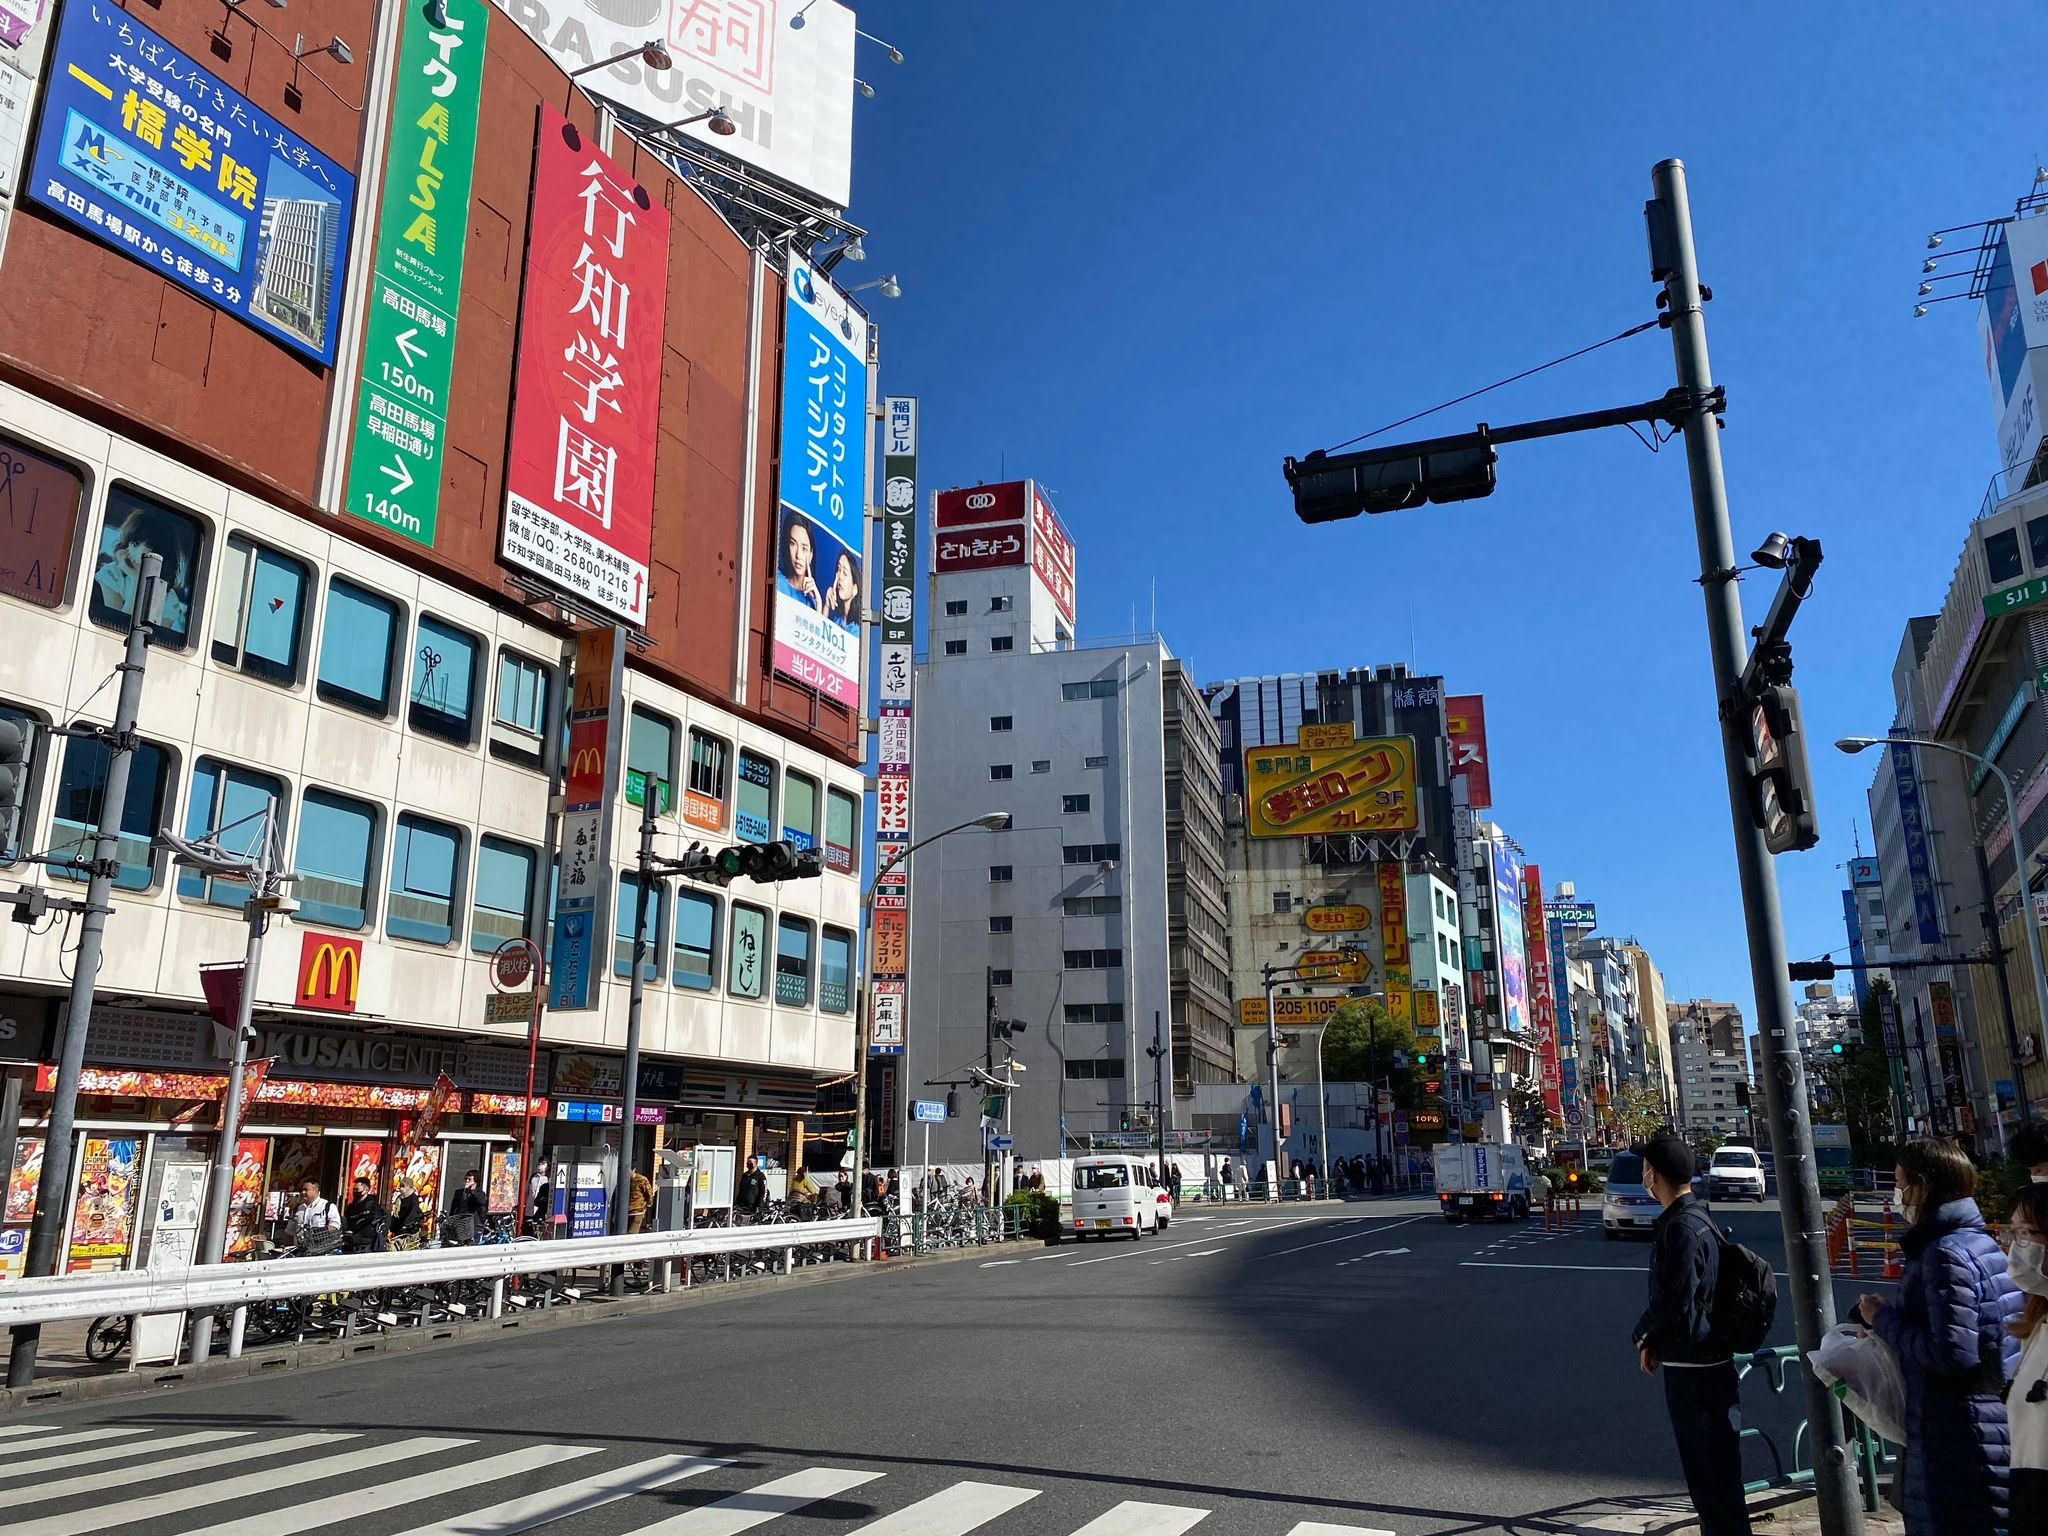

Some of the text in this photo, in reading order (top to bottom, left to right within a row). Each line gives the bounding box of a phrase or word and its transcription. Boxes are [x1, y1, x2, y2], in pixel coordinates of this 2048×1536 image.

[92, 5, 338, 192] いちばん行きたい大学へ。
[108, 53, 232, 148] 大学受験の名門
[68, 63, 259, 211] 一橋学院
[71, 156, 161, 218] メディカル
[134, 160, 189, 201] 一橋学院
[402, 102, 449, 256] ALSA
[131, 171, 236, 245] 医学部専門予備校
[47, 178, 242, 305] 高田馬場駅から徒歩3分
[166, 210, 235, 257] コネクト
[394, 261, 444, 295] 新生フィナンシャル
[382, 286, 447, 338] 高田馬場
[553, 158, 638, 531] 行知学園
[380, 361, 435, 406] 150m
[366, 415, 434, 461] 早稲田通り
[369, 392, 436, 441] 高田馬場
[806, 332, 831, 507] アイシティ
[829, 354, 848, 521] コンタクトの
[891, 400, 911, 453] 稲門ビル
[365, 492, 421, 534] 140m
[506, 539, 591, 592] 行知学园高田马场校
[940, 534, 1021, 560] さんきょう
[2006, 587, 2030, 606] SJI
[889, 630, 906, 639] 5F
[896, 719, 907, 762] 高田馬場
[1304, 736, 1349, 748] 1977
[1306, 726, 1347, 737] SINCE
[886, 764, 903, 772] 2F
[1265, 751, 1392, 823] 学生ローン
[880, 780, 892, 829] スロット
[895, 780, 907, 829] パチンコ
[879, 897, 904, 906] ATM
[1312, 909, 1365, 923] 学生ローン
[1378, 863, 1408, 964] 学生ローン
[500, 957, 529, 976] 消火栓
[738, 926, 756, 992] ねぎし
[495, 994, 534, 1005] 学生ローン
[876, 997, 894, 1039] 石庫門
[230, 1029, 371, 1072] OKUSAI
